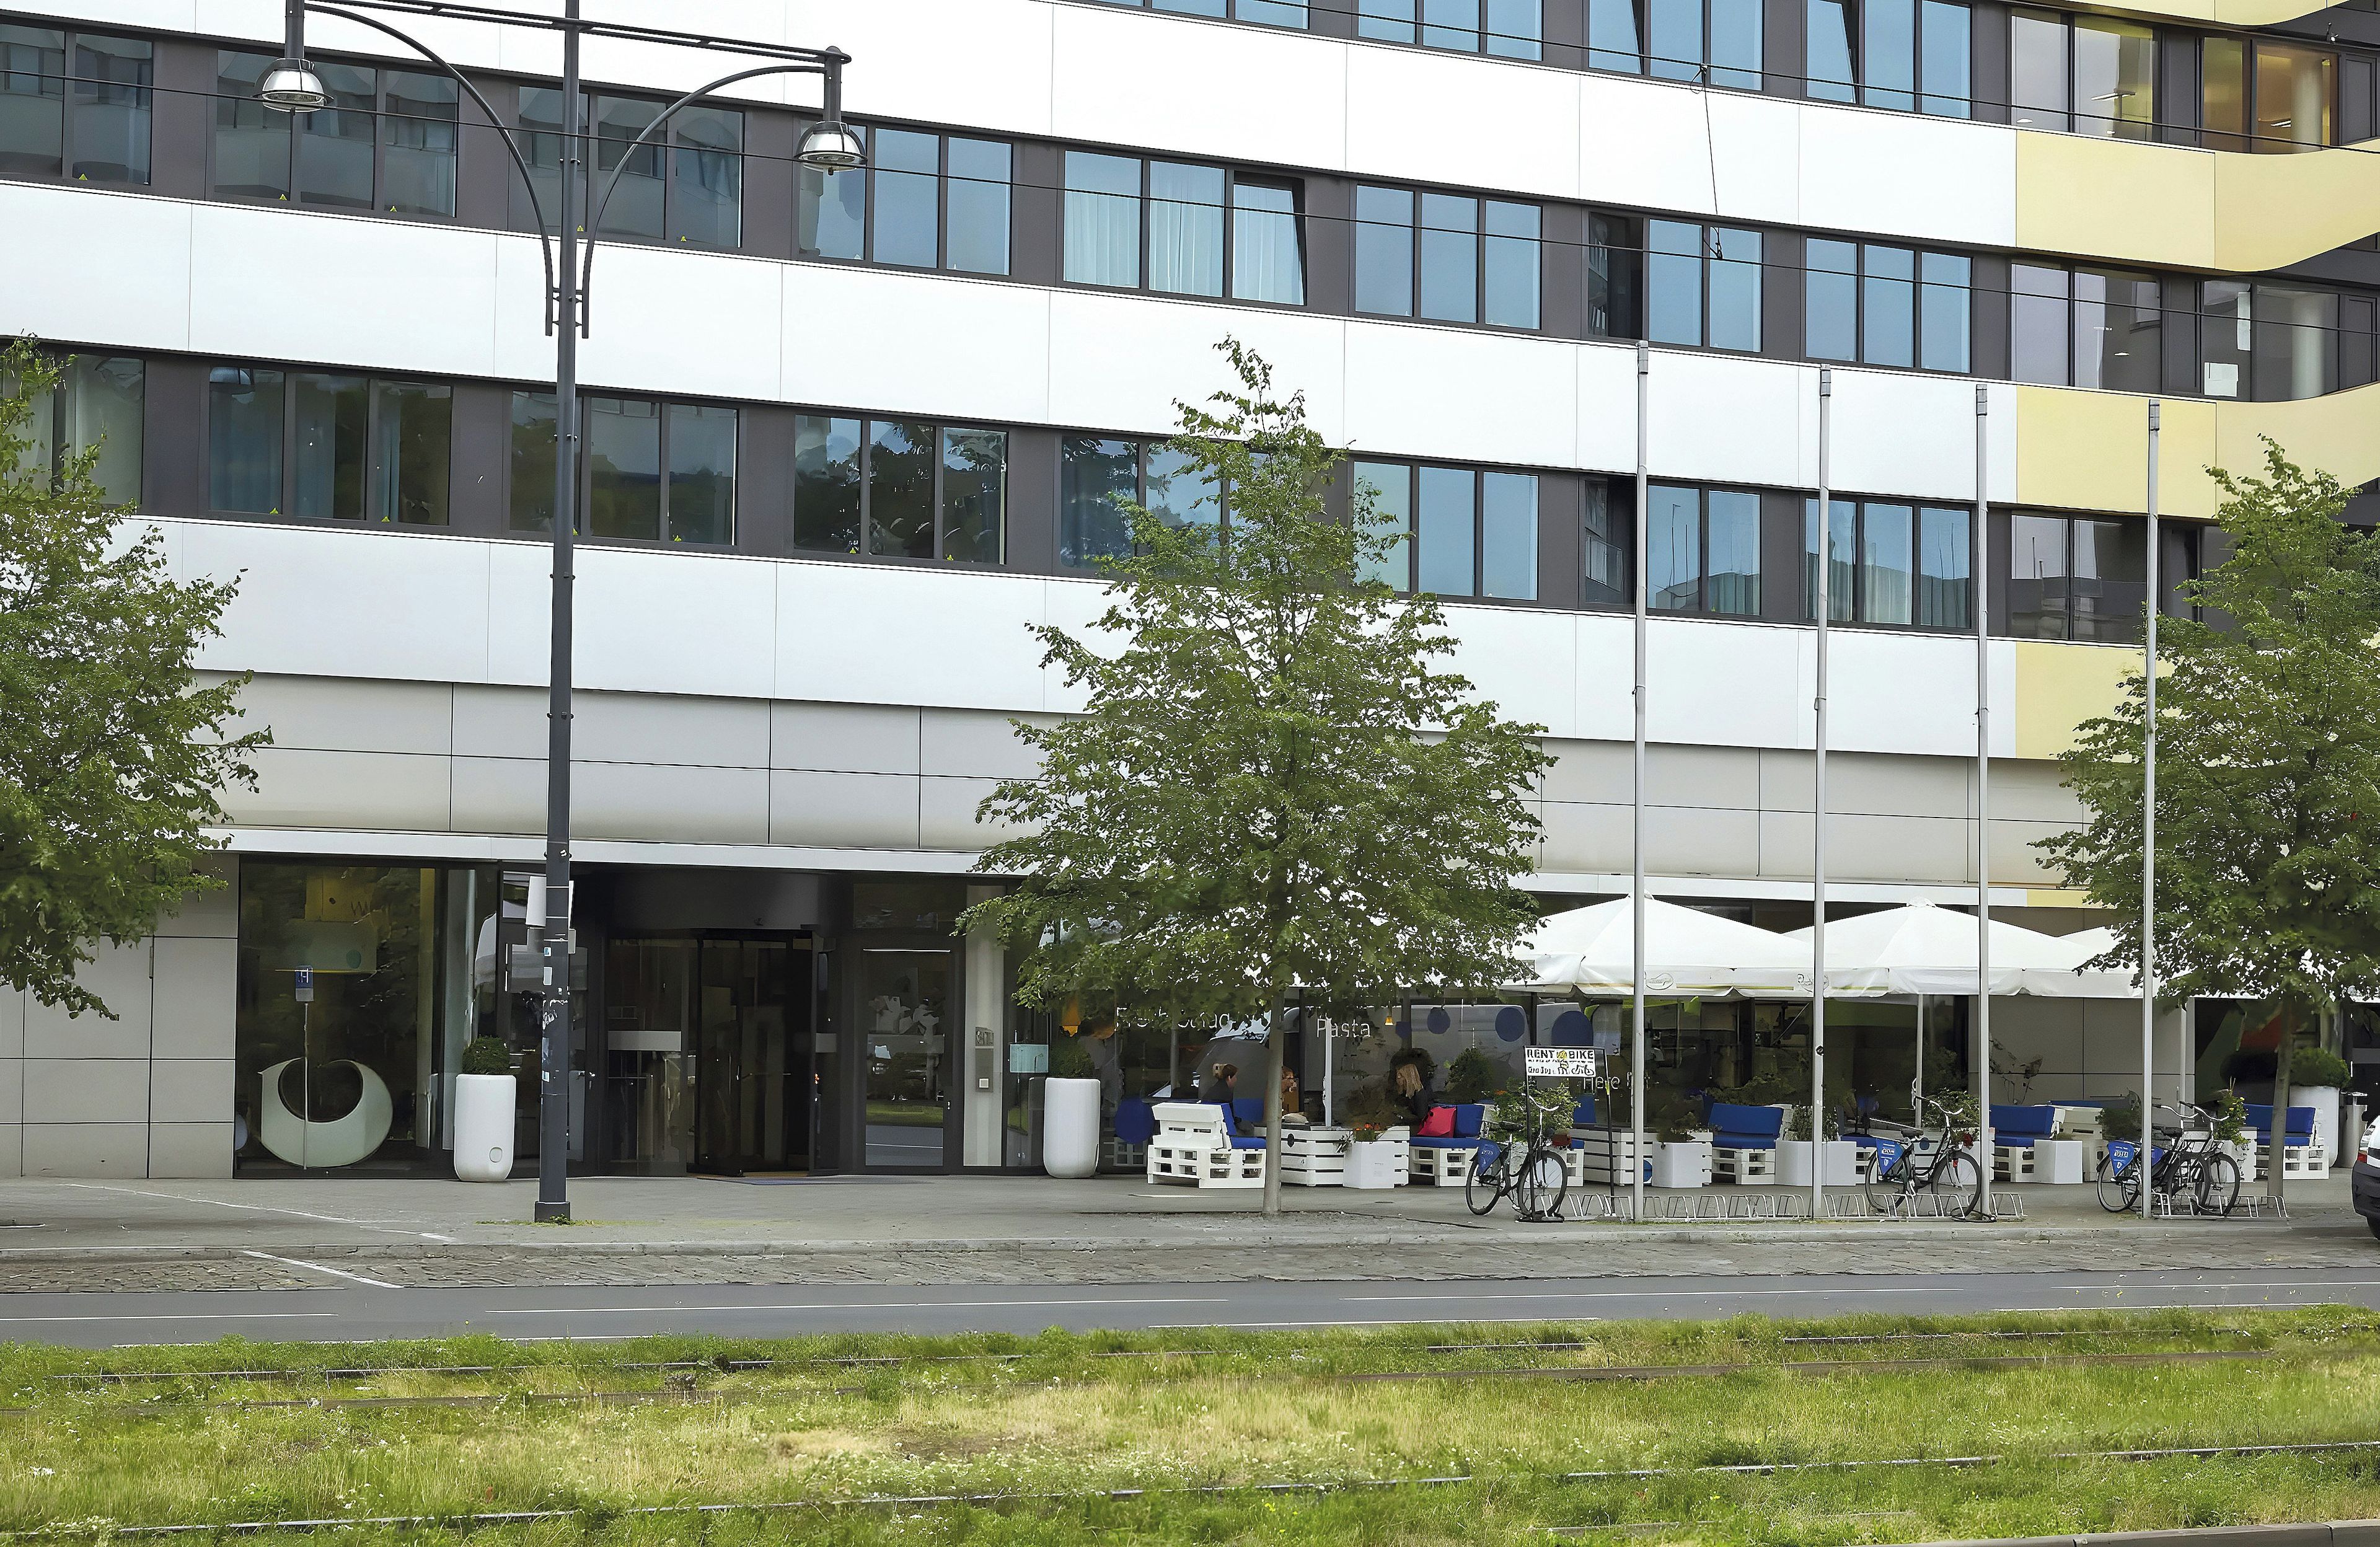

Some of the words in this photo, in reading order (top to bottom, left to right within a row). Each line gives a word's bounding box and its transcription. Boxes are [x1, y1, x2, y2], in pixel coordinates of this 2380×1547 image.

[1317, 1018, 1371, 1038] Pasta
[1527, 1049, 1555, 1059] RENT
[1568, 1050, 1594, 1060] BIKE
